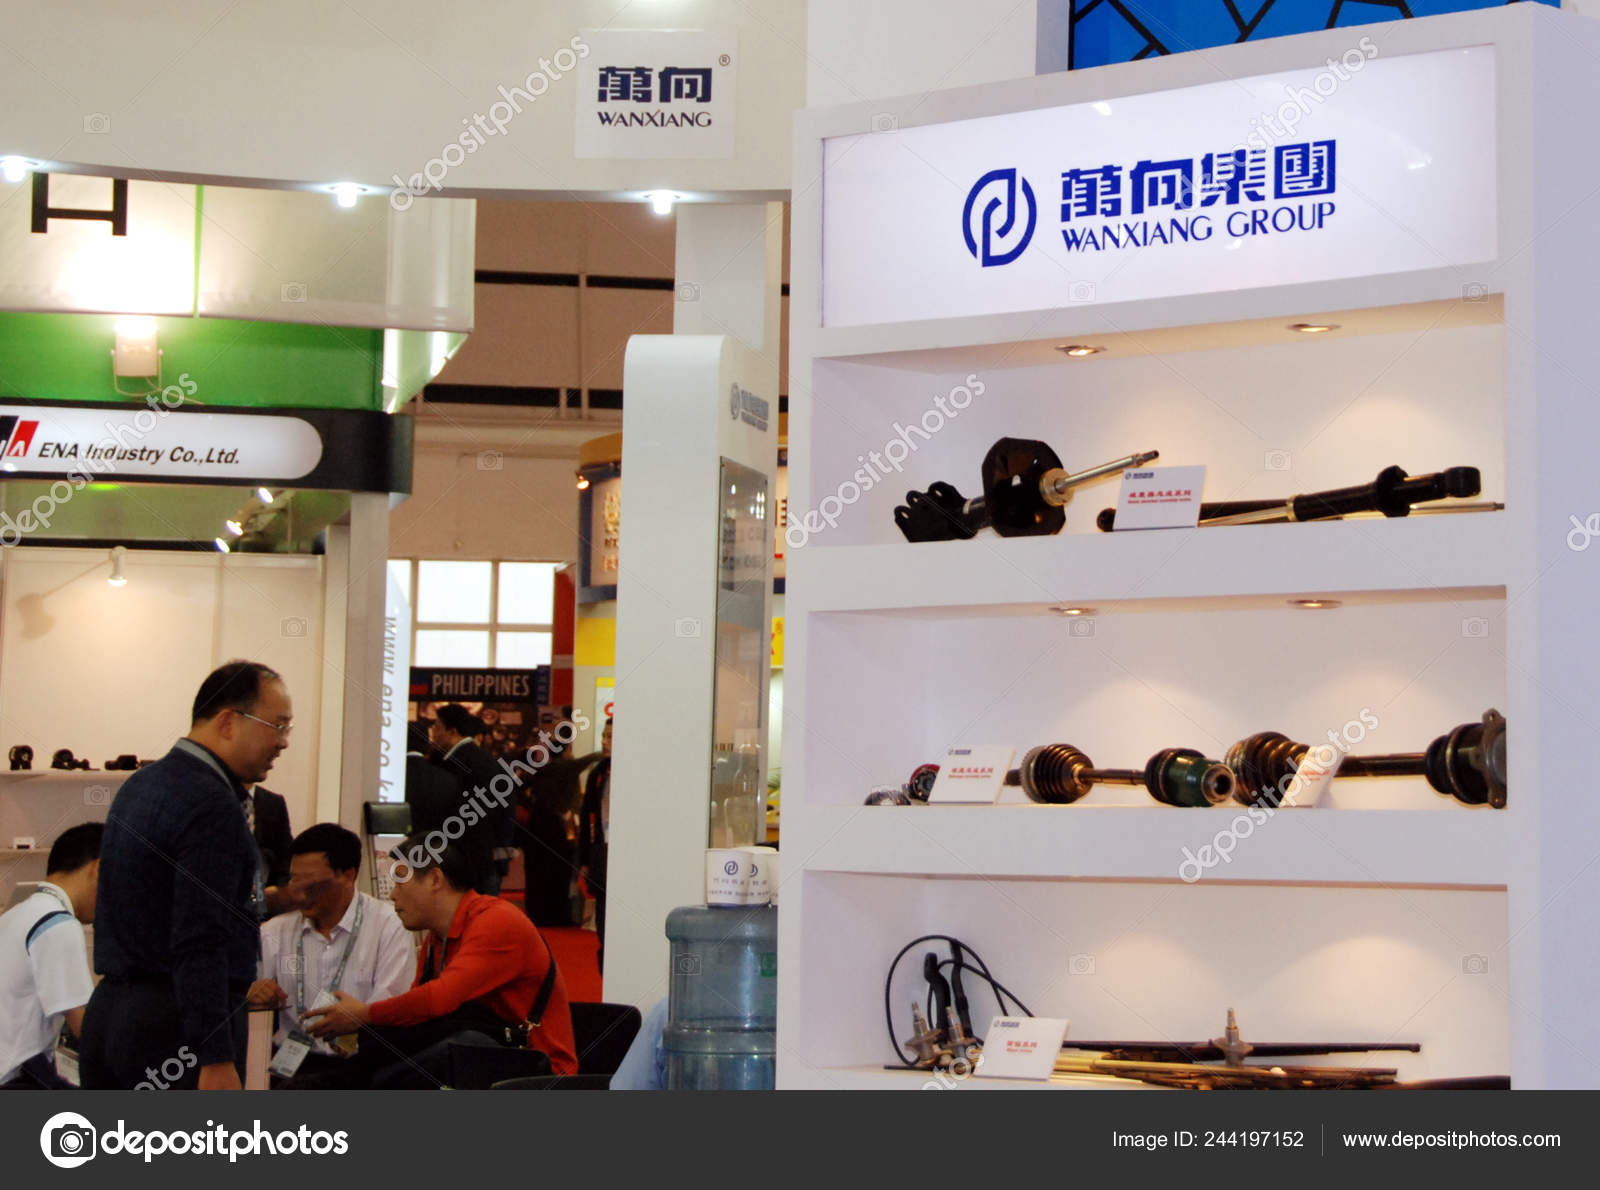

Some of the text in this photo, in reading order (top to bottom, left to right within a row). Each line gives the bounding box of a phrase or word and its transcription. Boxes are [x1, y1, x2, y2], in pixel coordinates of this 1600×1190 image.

[597, 109, 712, 128] WANXIANG
[1061, 201, 1336, 253] WANXIANG GROUP
[38, 442, 79, 458] ENA
[85, 443, 165, 465] Industry
[431, 673, 531, 697] PHILIPPINES
